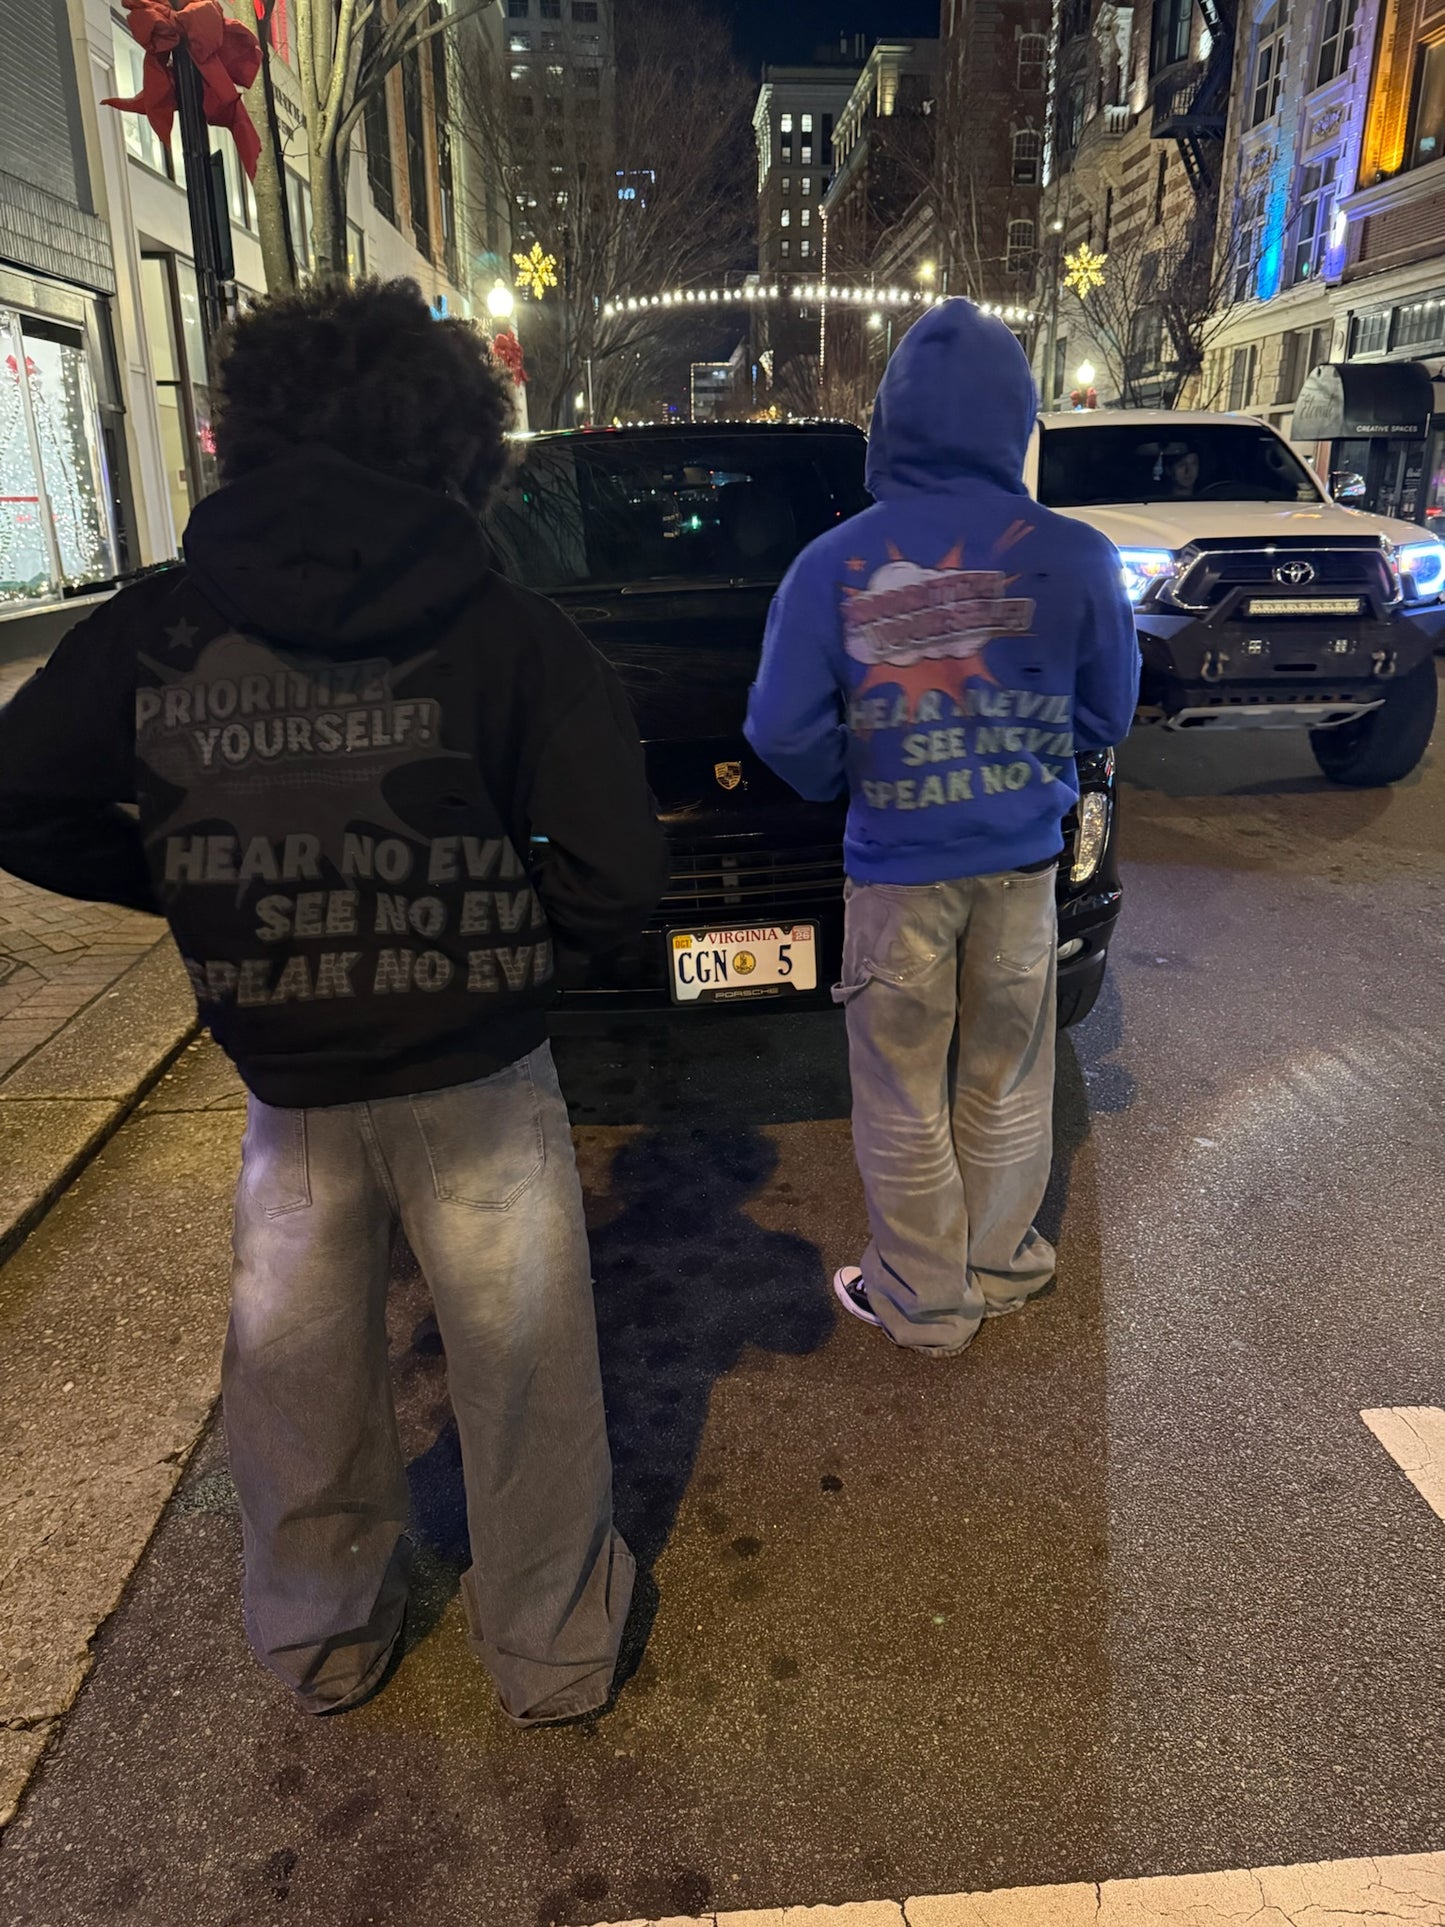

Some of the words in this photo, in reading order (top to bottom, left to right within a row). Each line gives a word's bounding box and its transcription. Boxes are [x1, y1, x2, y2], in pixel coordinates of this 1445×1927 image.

[1356, 424, 1390, 433] CREATIVE
[1391, 424, 1418, 433] SPACES
[135, 669, 386, 732] PRIORITIZE
[848, 690, 943, 730] HEAR
[193, 703, 431, 766] YOURSELF!
[901, 727, 967, 767] SEE
[980, 761, 1032, 795] NO
[164, 833, 323, 884] HEAR
[341, 832, 412, 884] NO
[428, 834, 527, 885] EVI
[255, 889, 361, 943] SEE
[374, 891, 447, 939] NO
[459, 888, 547, 936] EVI
[708, 929, 779, 944] VIRGINIA
[373, 948, 454, 994] NO
[466, 937, 554, 993] EVI
[678, 950, 728, 984] CGN
[778, 944, 793, 975] 5
[715, 988, 779, 999] PORSCHE
